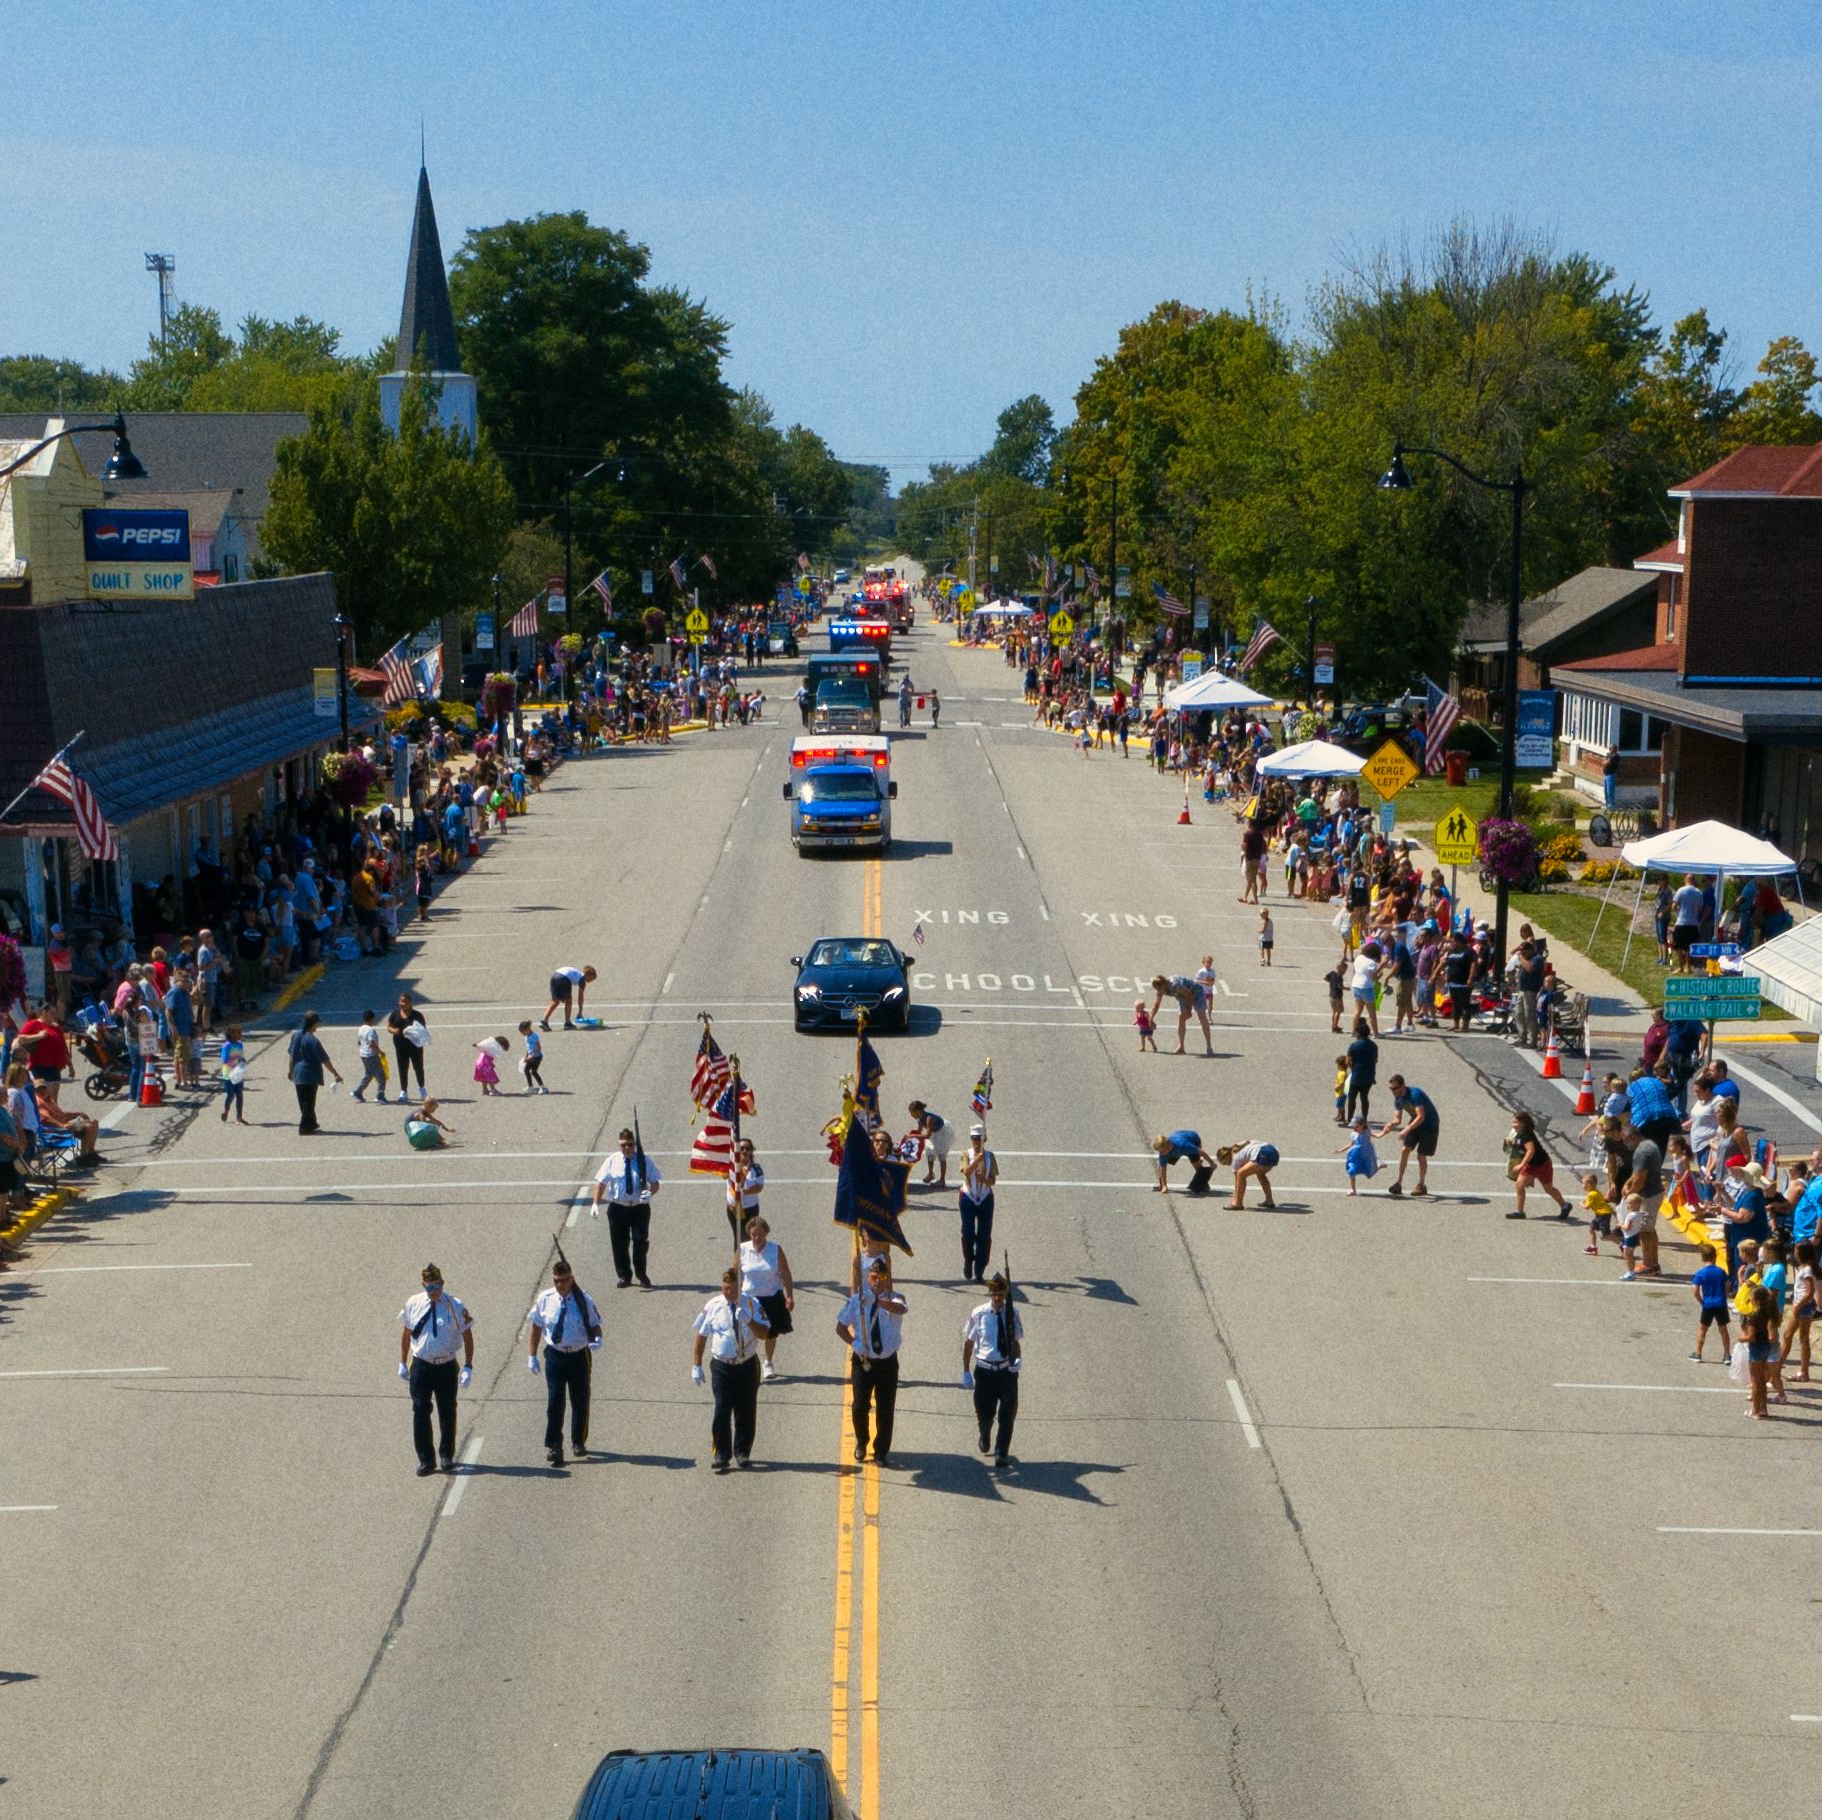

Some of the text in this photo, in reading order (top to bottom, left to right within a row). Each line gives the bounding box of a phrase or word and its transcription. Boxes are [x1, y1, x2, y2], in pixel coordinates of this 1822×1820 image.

[122, 528, 181, 544] PEPSI
[92, 573, 183, 590] QUILT SHOP
[1373, 767, 1405, 776] MERGE
[1377, 778, 1399, 787] LEFT
[1442, 851, 1470, 860] AHEAD
[1354, 876, 1365, 889] 12
[914, 909, 1010, 925] XING
[1082, 911, 1178, 929] XING
[912, 973, 1071, 994] CHOOL
[1680, 979, 1757, 994] HISTORIC ROUTE
[1669, 1002, 1743, 1017] WALKING TRAIL
